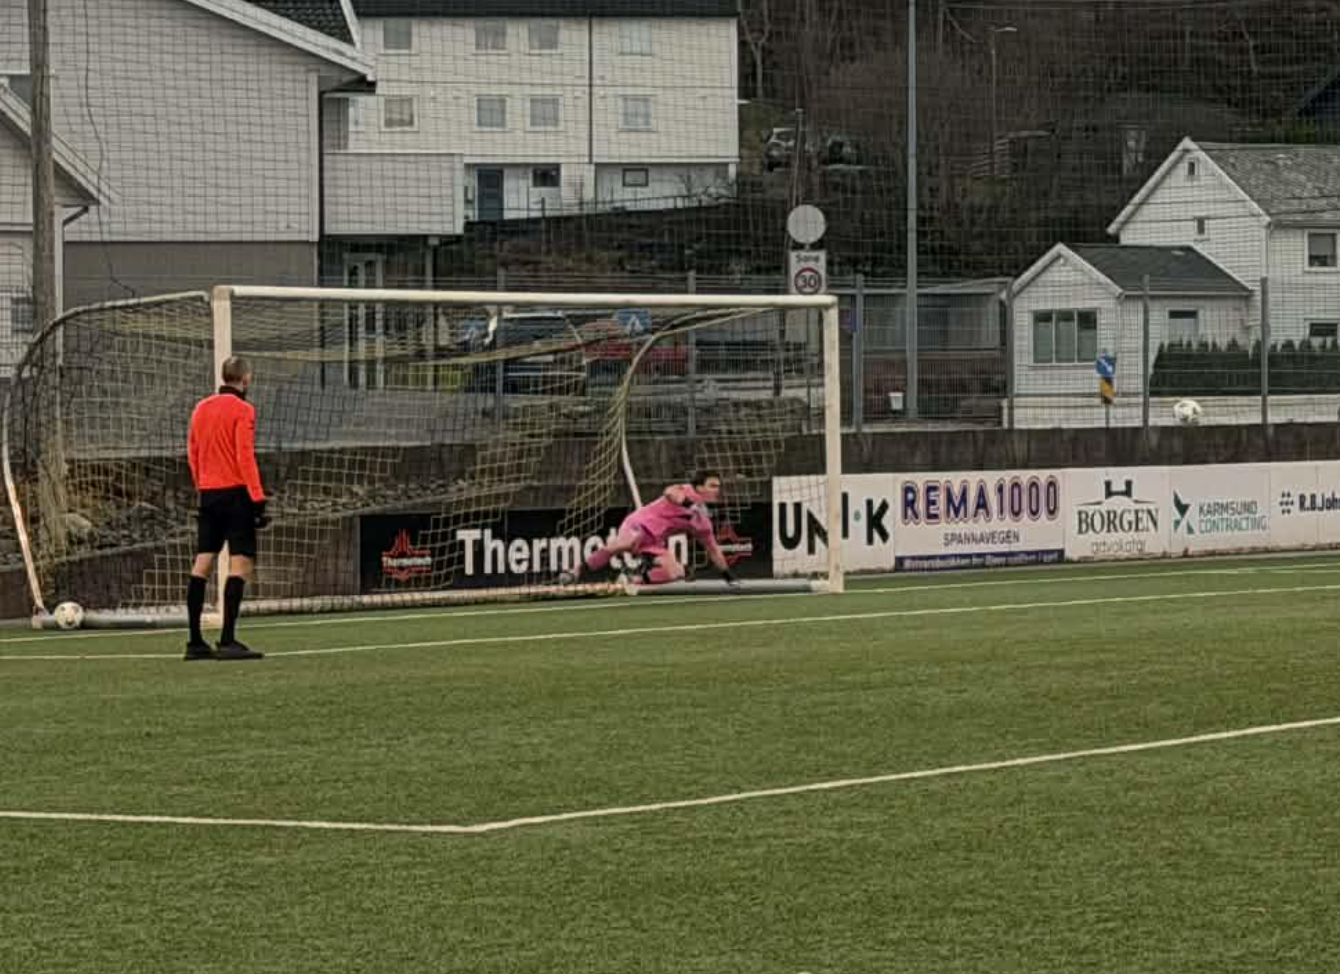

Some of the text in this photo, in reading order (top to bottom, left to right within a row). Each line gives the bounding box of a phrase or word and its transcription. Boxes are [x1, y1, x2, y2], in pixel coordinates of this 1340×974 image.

[799, 274, 817, 288] 30
[1199, 500, 1258, 517] KARMSUND
[1076, 507, 1160, 536] BORGEN
[1199, 516, 1268, 535] CONTRACTING
[943, 529, 1020, 548] SPANNAVEGEN
